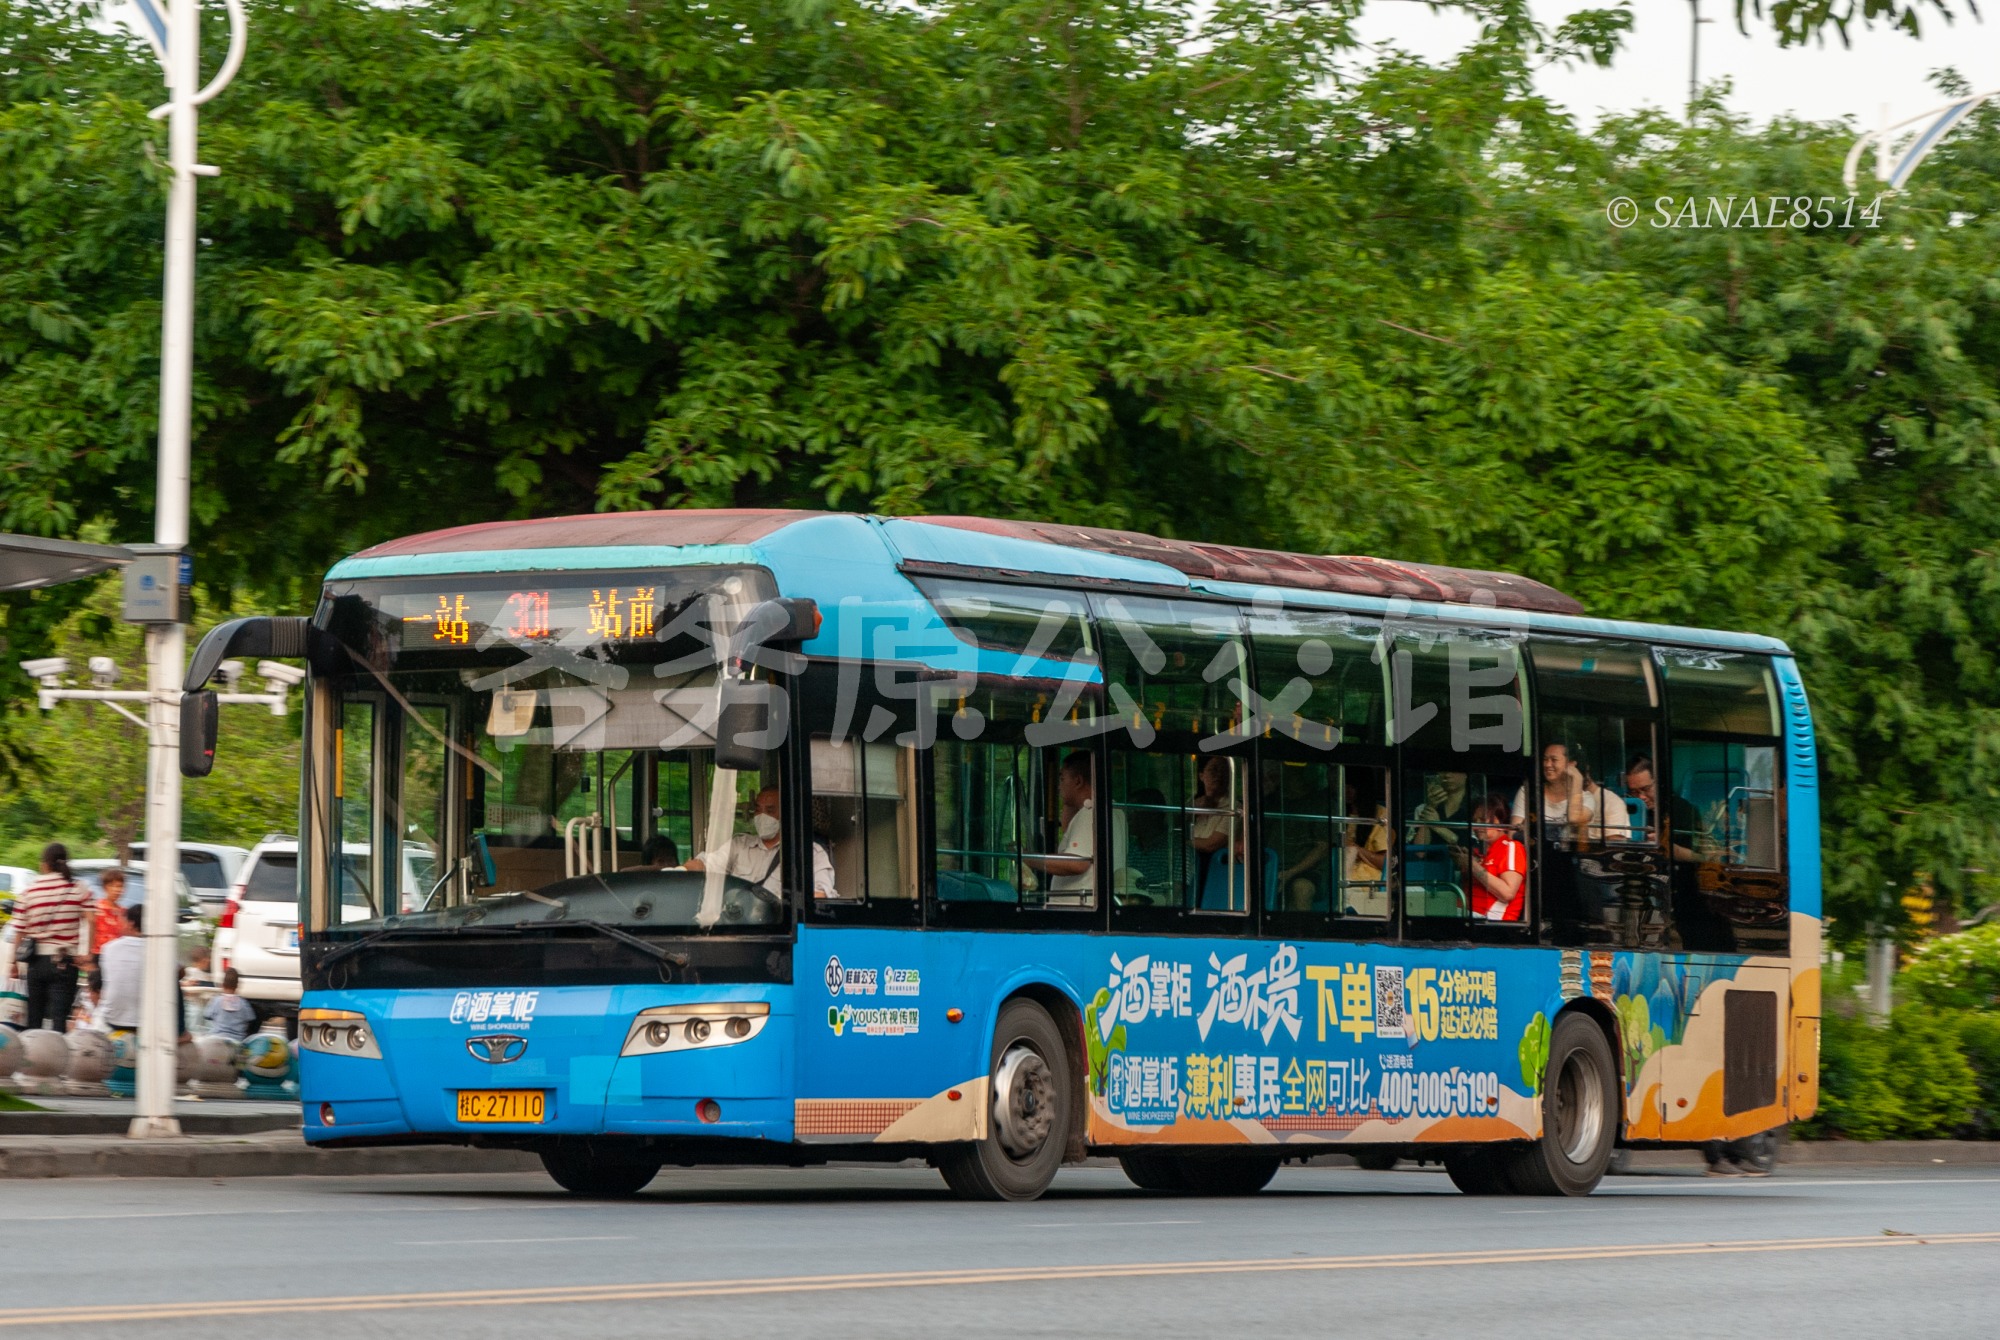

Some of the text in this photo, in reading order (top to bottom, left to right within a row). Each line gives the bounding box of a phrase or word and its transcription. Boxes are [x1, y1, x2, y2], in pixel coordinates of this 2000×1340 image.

[402, 594, 470, 644] 一站
[508, 592, 549, 638] 301
[845, 970, 877, 985] 桂林公交
[1099, 942, 1440, 1047] 酒掌柜 酒不贵 下单 15
[1438, 969, 1498, 1005] 分钟开喝
[467, 991, 540, 1022] 酒掌柜
[1440, 1005, 1499, 1041] 延迟必赔
[1386, 1054, 1414, 1069] 送酒电话
[1124, 1052, 1371, 1116] 酒掌柜 薄利惠民 全网可比
[1378, 1071, 1499, 1114] 400-006-6199
[1141, 1110, 1175, 1121] SHOPKEEPER
